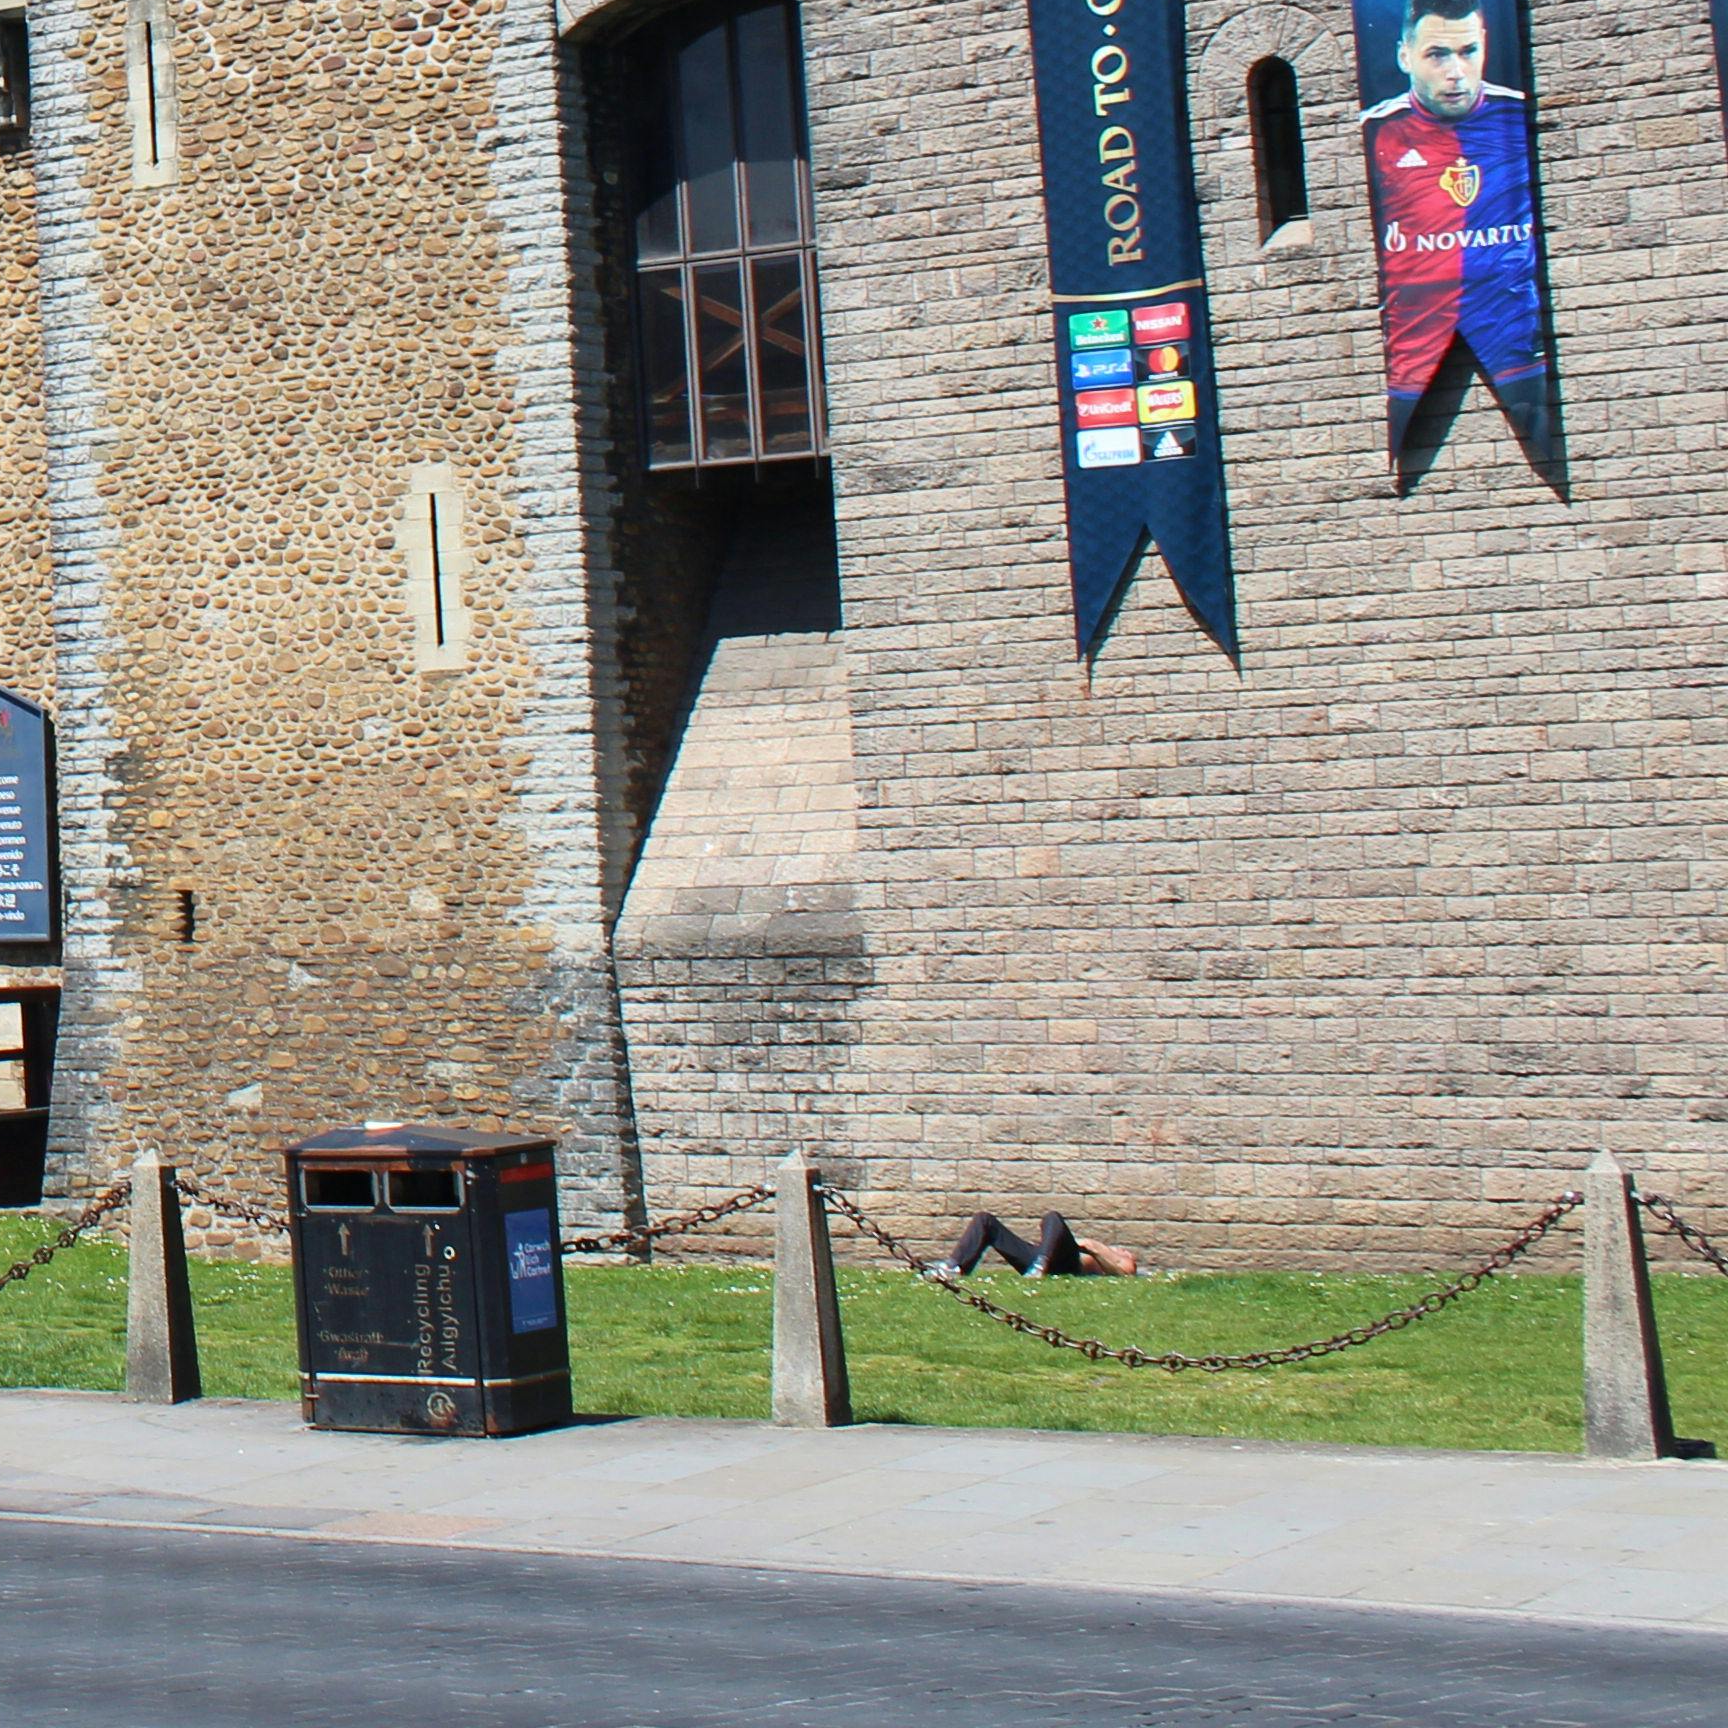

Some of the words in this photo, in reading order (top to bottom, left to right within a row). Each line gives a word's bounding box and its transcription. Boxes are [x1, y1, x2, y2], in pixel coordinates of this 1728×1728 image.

[1091, 43, 1132, 117] TO
[1099, 124, 1144, 267] ROAD
[1415, 223, 1533, 252] NOVARTIS
[1135, 315, 1183, 331] NISSAN
[1092, 362, 1132, 376] PS4
[413, 1263, 436, 1376] Recycling
[436, 1264, 461, 1371] Ailgylchu
